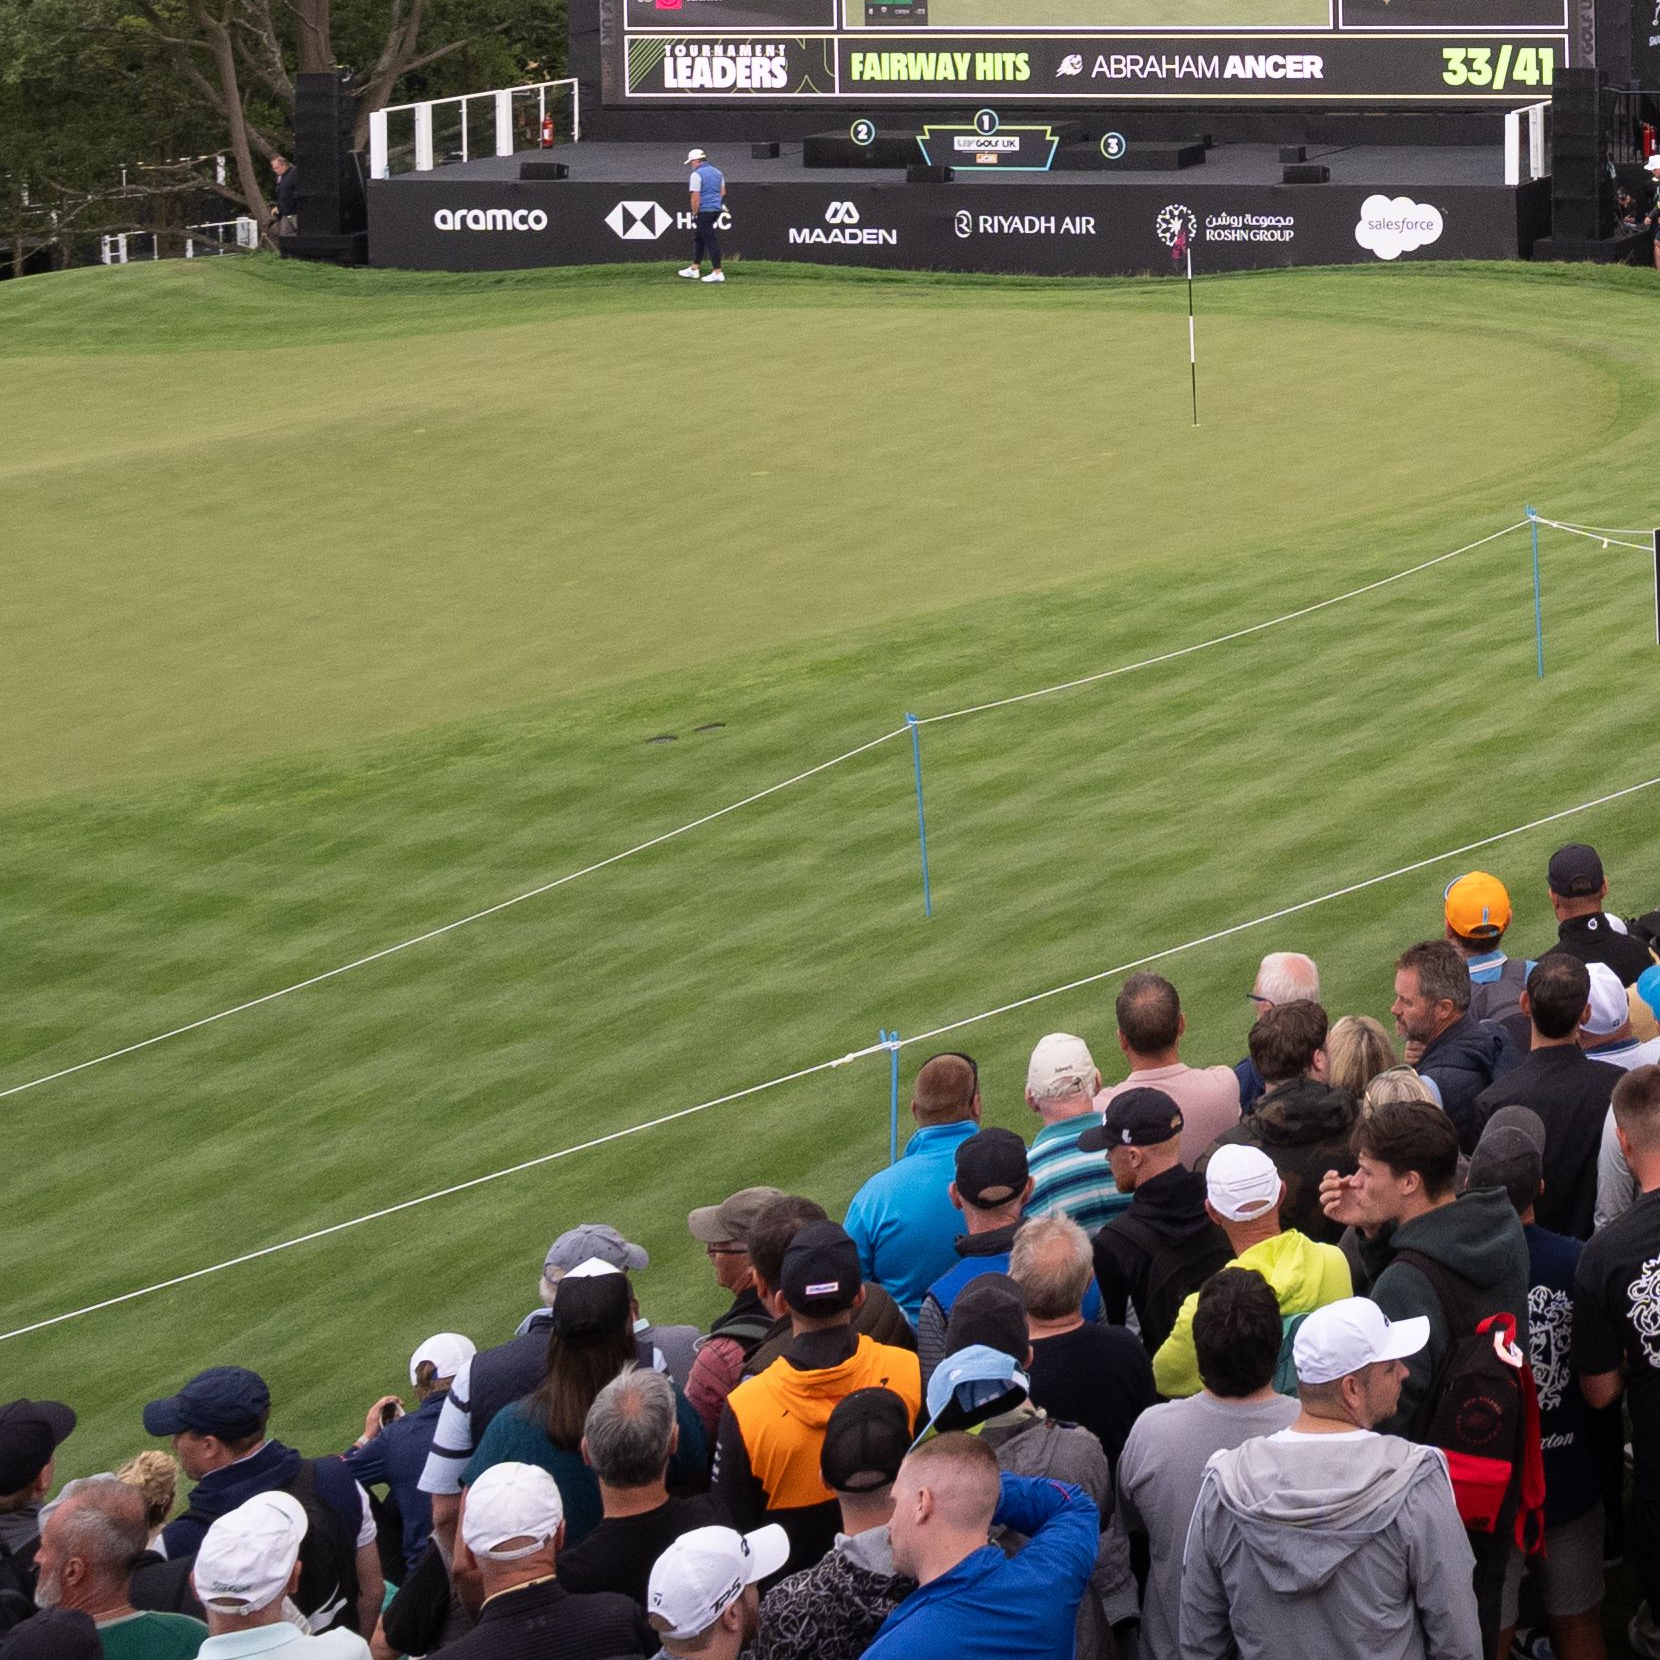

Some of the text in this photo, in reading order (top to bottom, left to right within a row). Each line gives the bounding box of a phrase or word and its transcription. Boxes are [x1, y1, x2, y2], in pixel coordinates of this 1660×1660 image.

[664, 44, 787, 57] TOURNAMENT
[664, 56, 788, 88] LEADERS
[851, 52, 1030, 81] FAIRWAY HITS
[1091, 54, 1324, 79] ABRAHAM ANCER
[1442, 44, 1554, 90] 33/41
[982, 114, 990, 130] 1
[856, 125, 869, 140] 2
[976, 139, 1016, 148] GOLF UK
[1107, 138, 1120, 154] 3
[434, 209, 548, 231] aramco
[677, 211, 732, 230] HC
[979, 216, 1096, 234] RIYADH AIR
[1206, 211, 1294, 228] مجموعة روشن
[1368, 216, 1434, 234] salesforce
[789, 228, 898, 244] MAADEN
[1206, 229, 1294, 241] ROSHN GROUP
